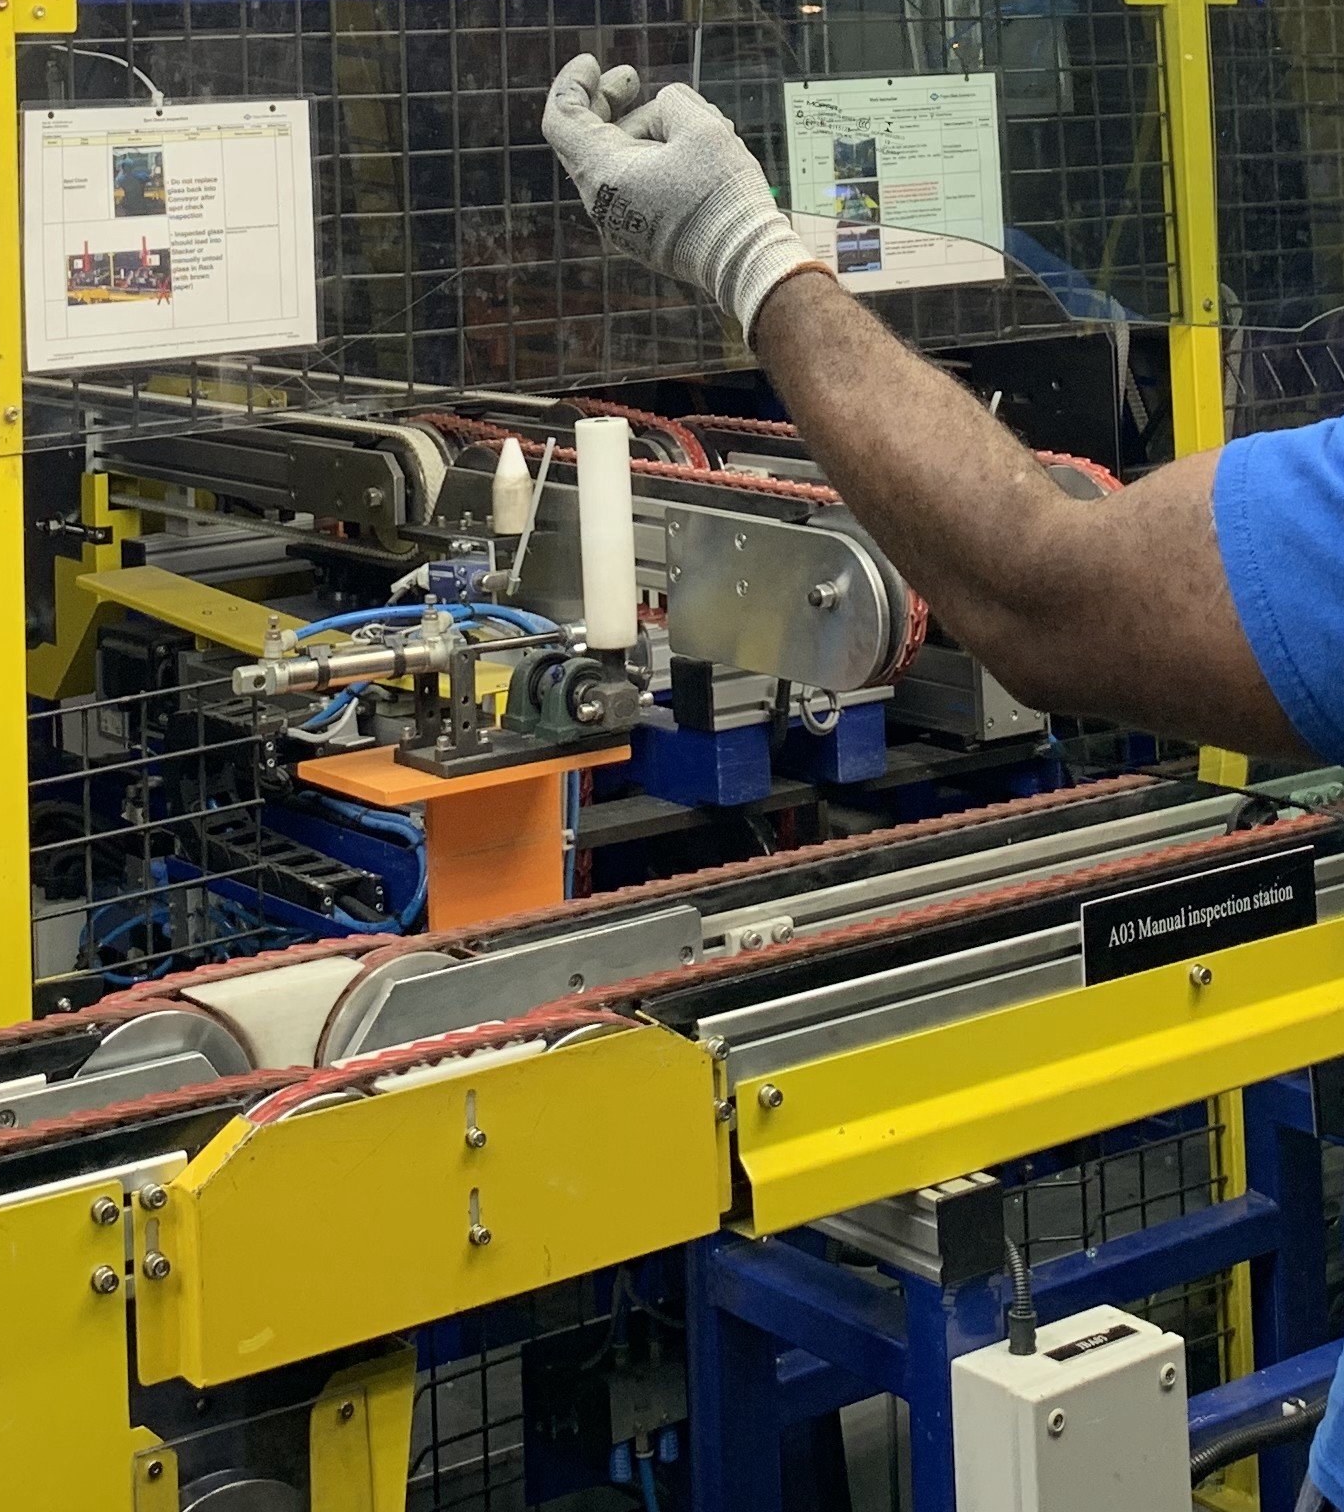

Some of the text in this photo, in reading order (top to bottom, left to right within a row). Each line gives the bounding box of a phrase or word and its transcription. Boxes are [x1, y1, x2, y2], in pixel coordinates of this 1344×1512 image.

[1108, 883, 1294, 948] A03 Manual inspection station
